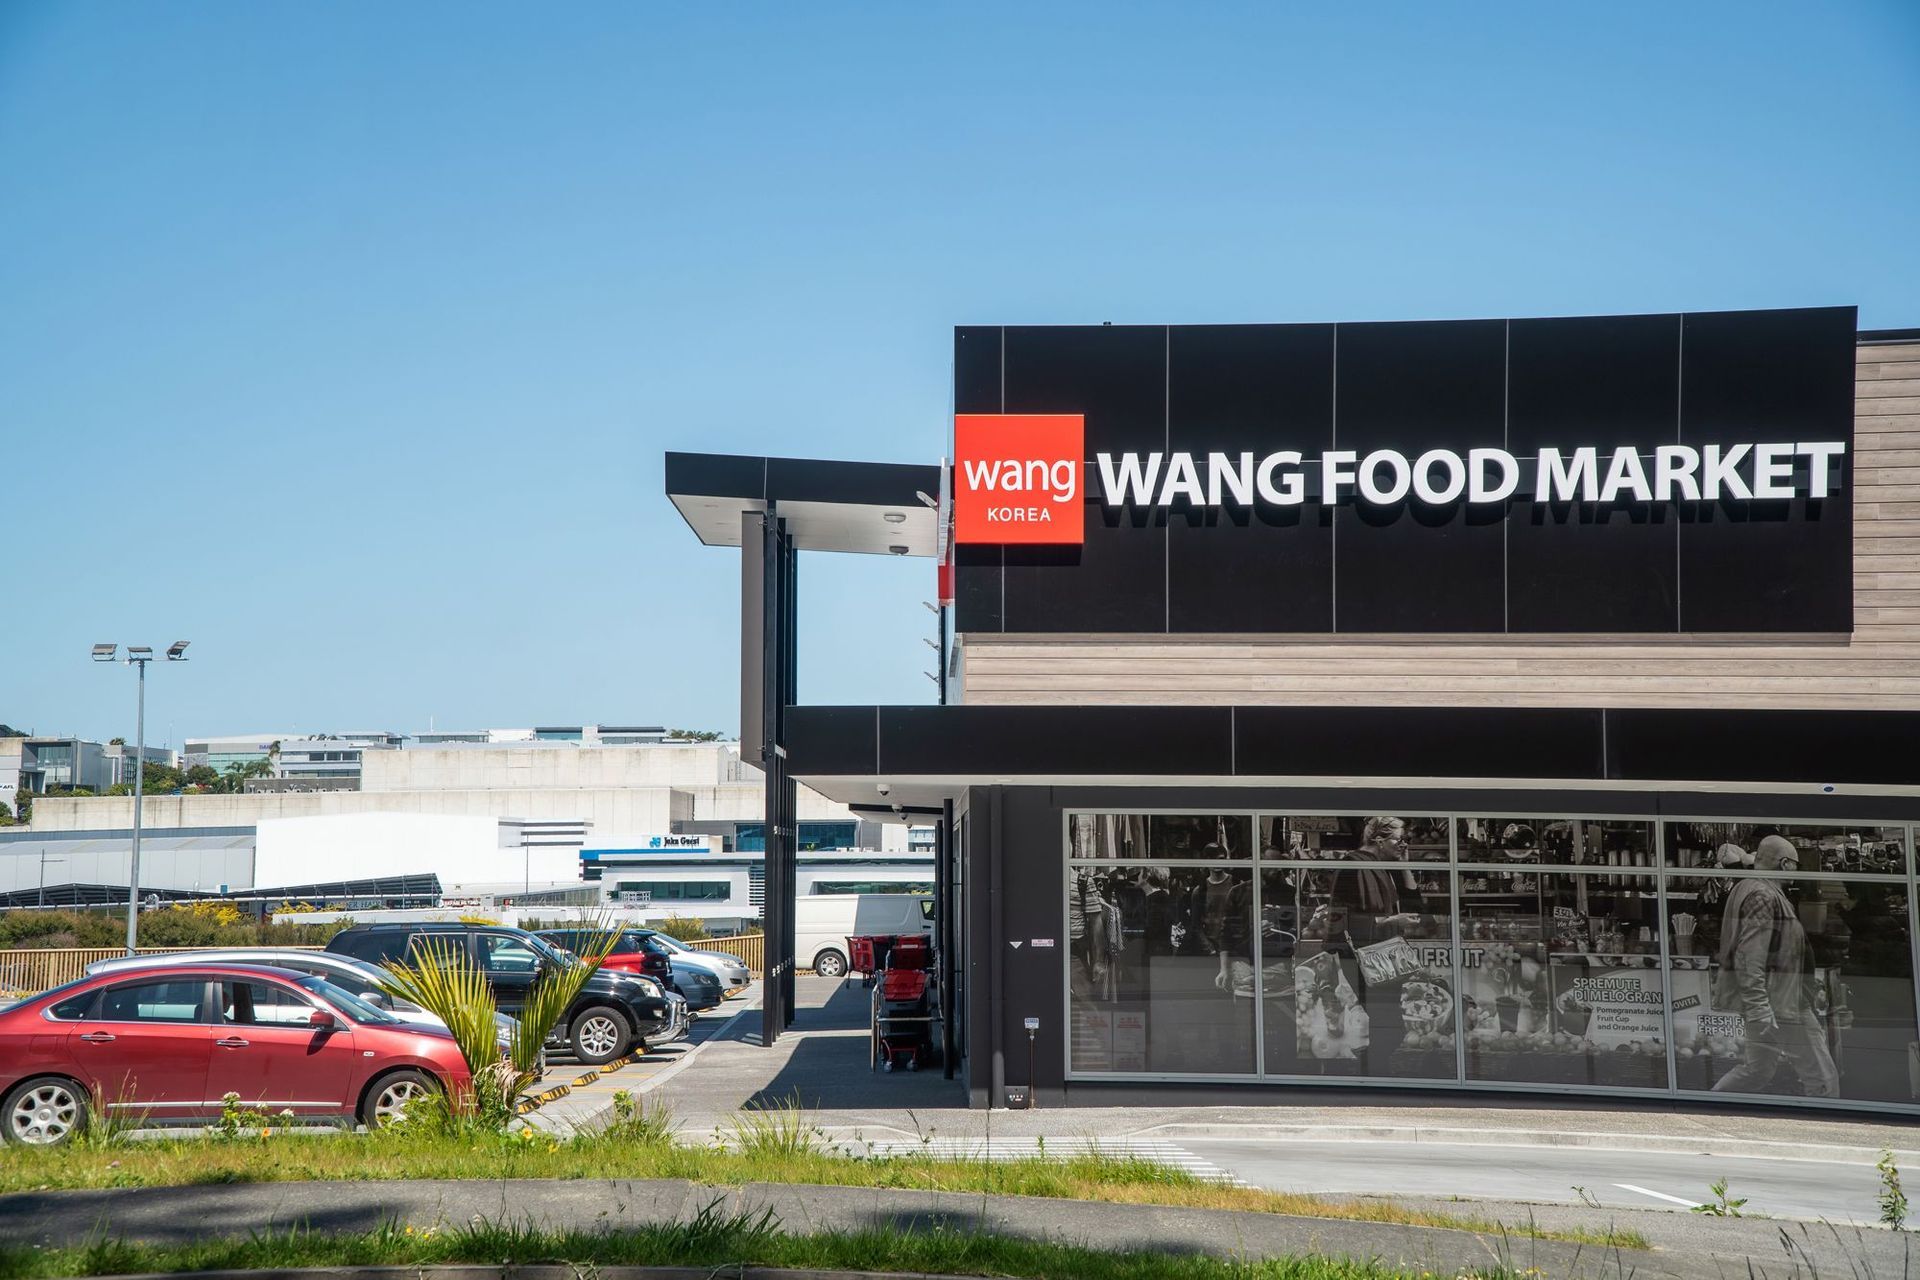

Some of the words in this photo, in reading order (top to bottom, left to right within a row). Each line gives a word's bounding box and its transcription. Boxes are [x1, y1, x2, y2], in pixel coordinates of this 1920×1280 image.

[1096, 451, 1305, 506] WANG
[1322, 447, 1520, 506] FOOD
[1535, 441, 1846, 502] MARKET
[963, 459, 1077, 502] wang
[987, 507, 1052, 522] KOREA
[664, 836, 679, 846] John
[1573, 977, 1641, 991] SPREMUTE
[1574, 990, 1588, 1001] DI
[1589, 991, 1663, 1004] MELOGRAN
[1596, 1006, 1645, 1015] Pomegranate
[1646, 1008, 1665, 1016] Juice
[1615, 1015, 1630, 1023] Cup
[1697, 1015, 1733, 1026] FRESH
[1612, 1024, 1640, 1033] Orange
[1641, 1024, 1660, 1032] Juice
